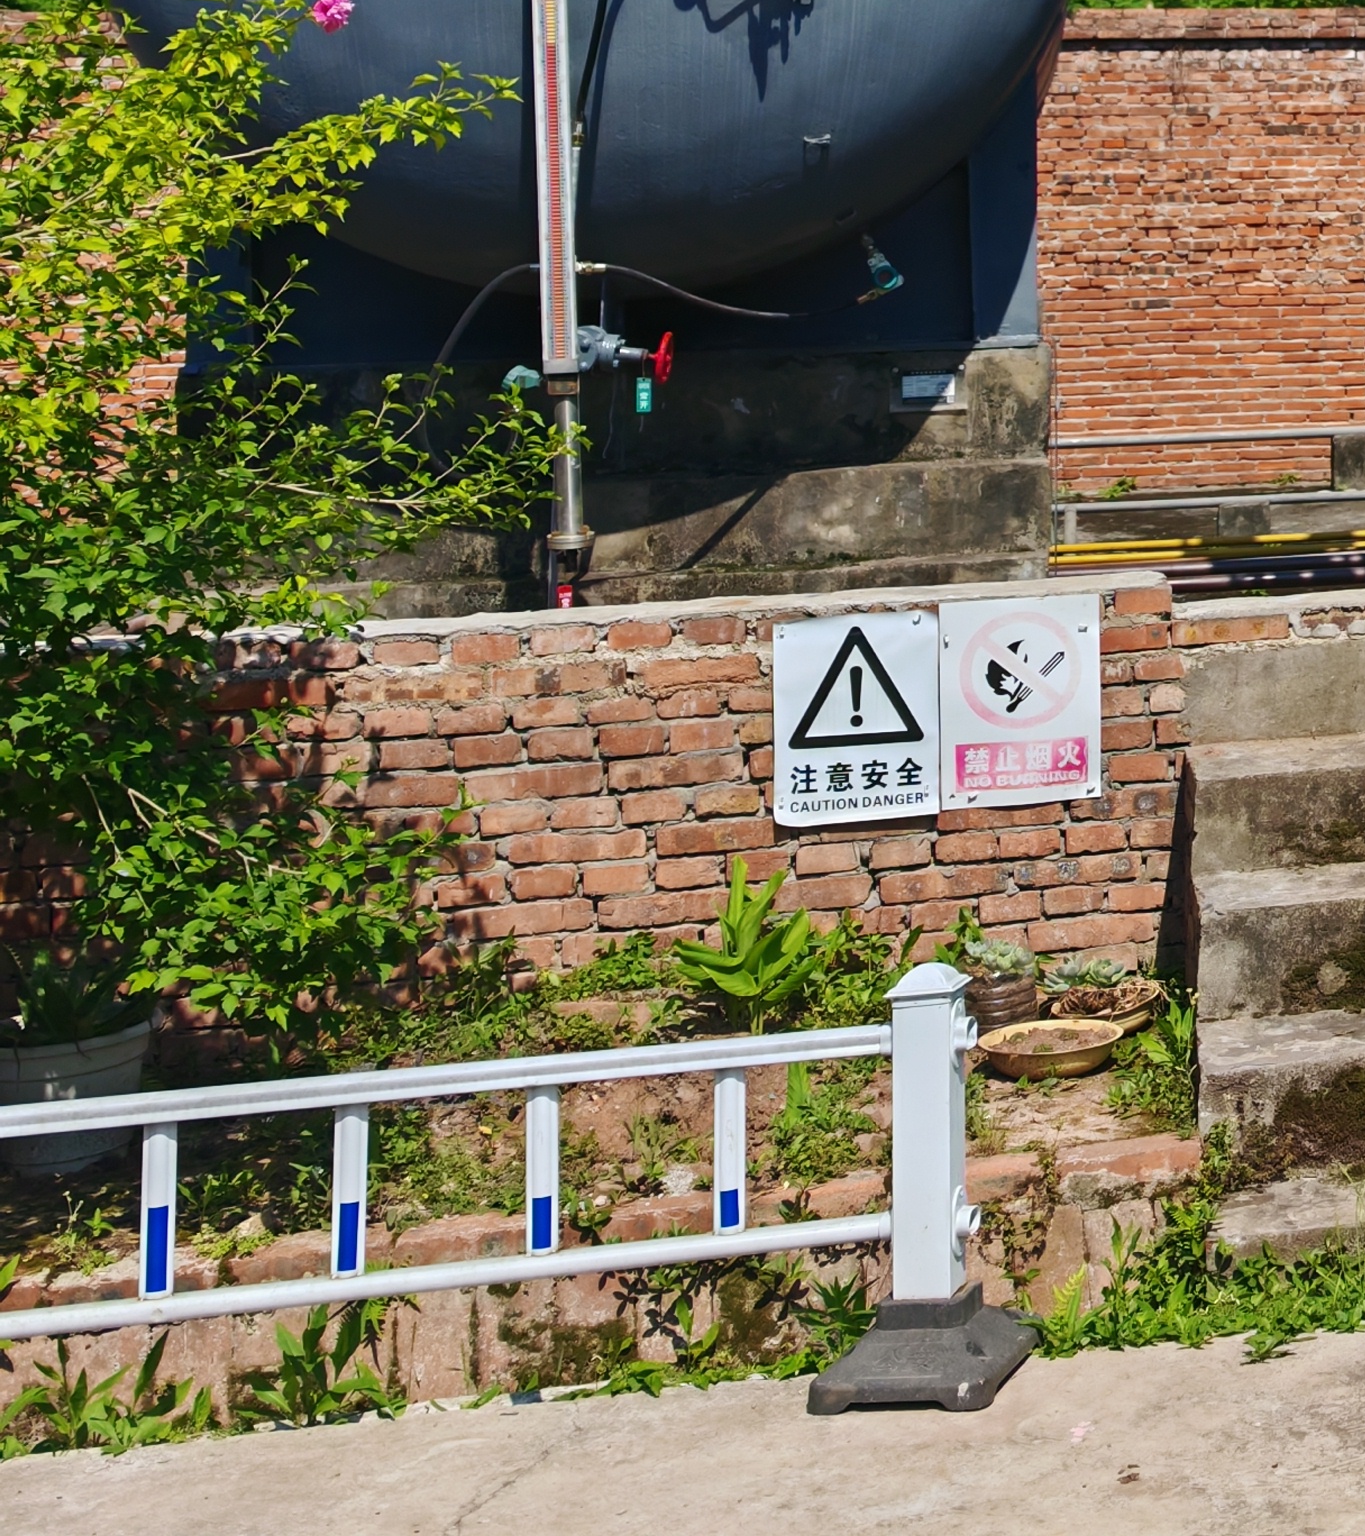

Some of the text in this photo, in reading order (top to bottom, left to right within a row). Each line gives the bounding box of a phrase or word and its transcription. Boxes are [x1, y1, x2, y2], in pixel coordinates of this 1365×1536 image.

[964, 742, 1081, 775] 禁止烟火
[790, 758, 923, 794] 注意安全
[965, 769, 1081, 789] NO BURNING
[790, 792, 924, 813] CAUTION DANGER
